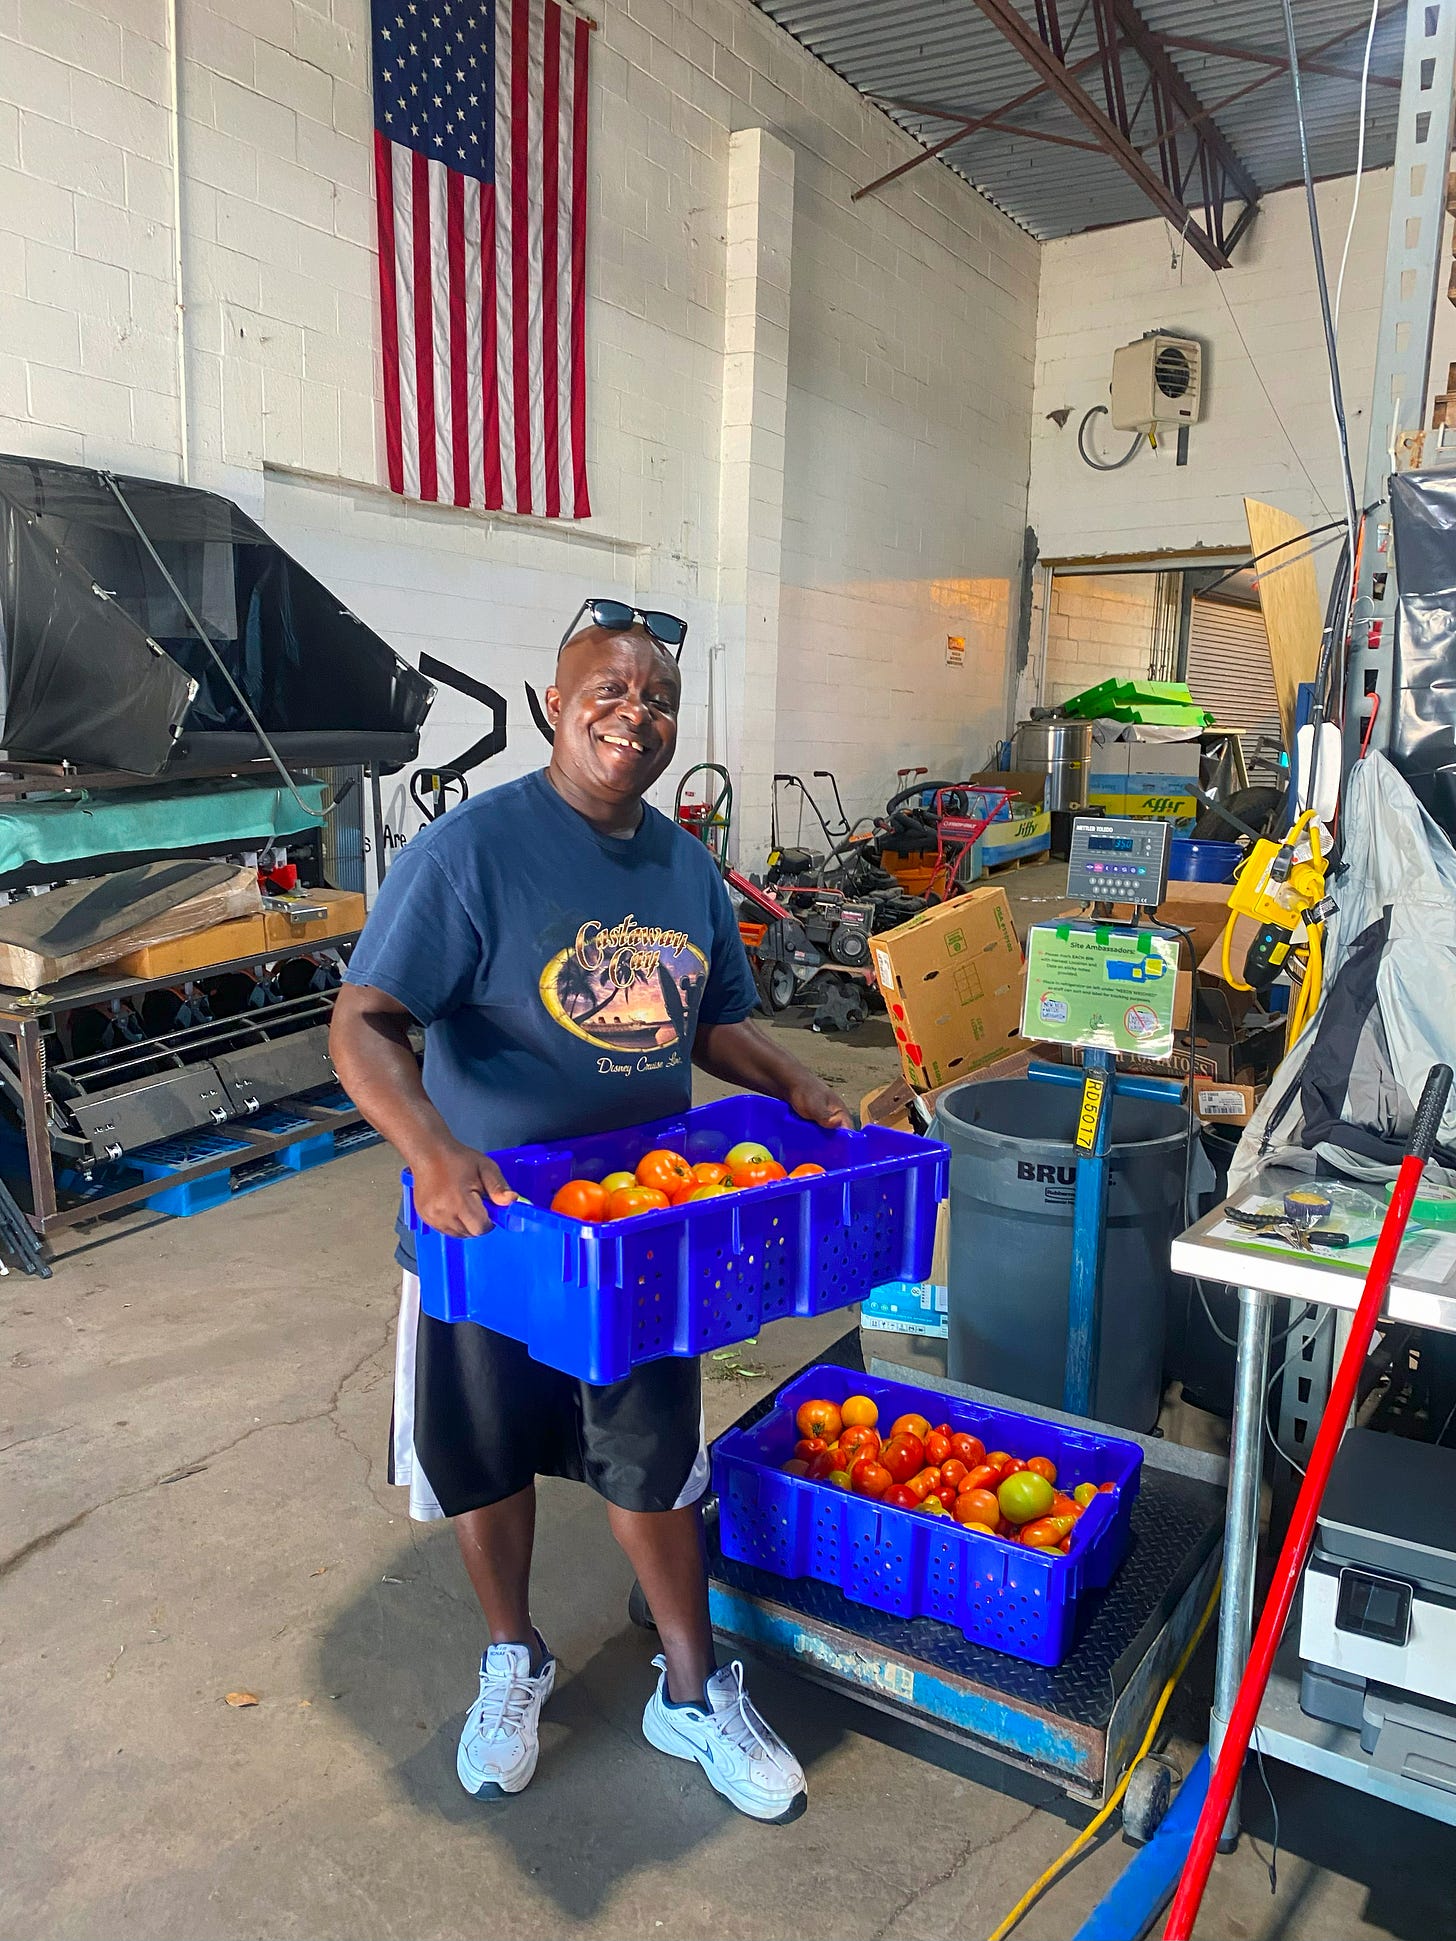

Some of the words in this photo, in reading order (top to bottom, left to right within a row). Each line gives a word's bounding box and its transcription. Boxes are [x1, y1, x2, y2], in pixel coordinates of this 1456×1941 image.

[1142, 797, 1185, 813] Jiffy
[384, 825, 407, 848] Are
[1014, 820, 1037, 837] Jiffy
[576, 914, 688, 971] Castaway
[1085, 943, 1136, 955] Ambassadors:
[609, 946, 660, 988] Cay
[597, 1057, 632, 1077] Disney
[636, 1056, 664, 1072] Cruise
[1078, 1080, 1103, 1147] RD5017
